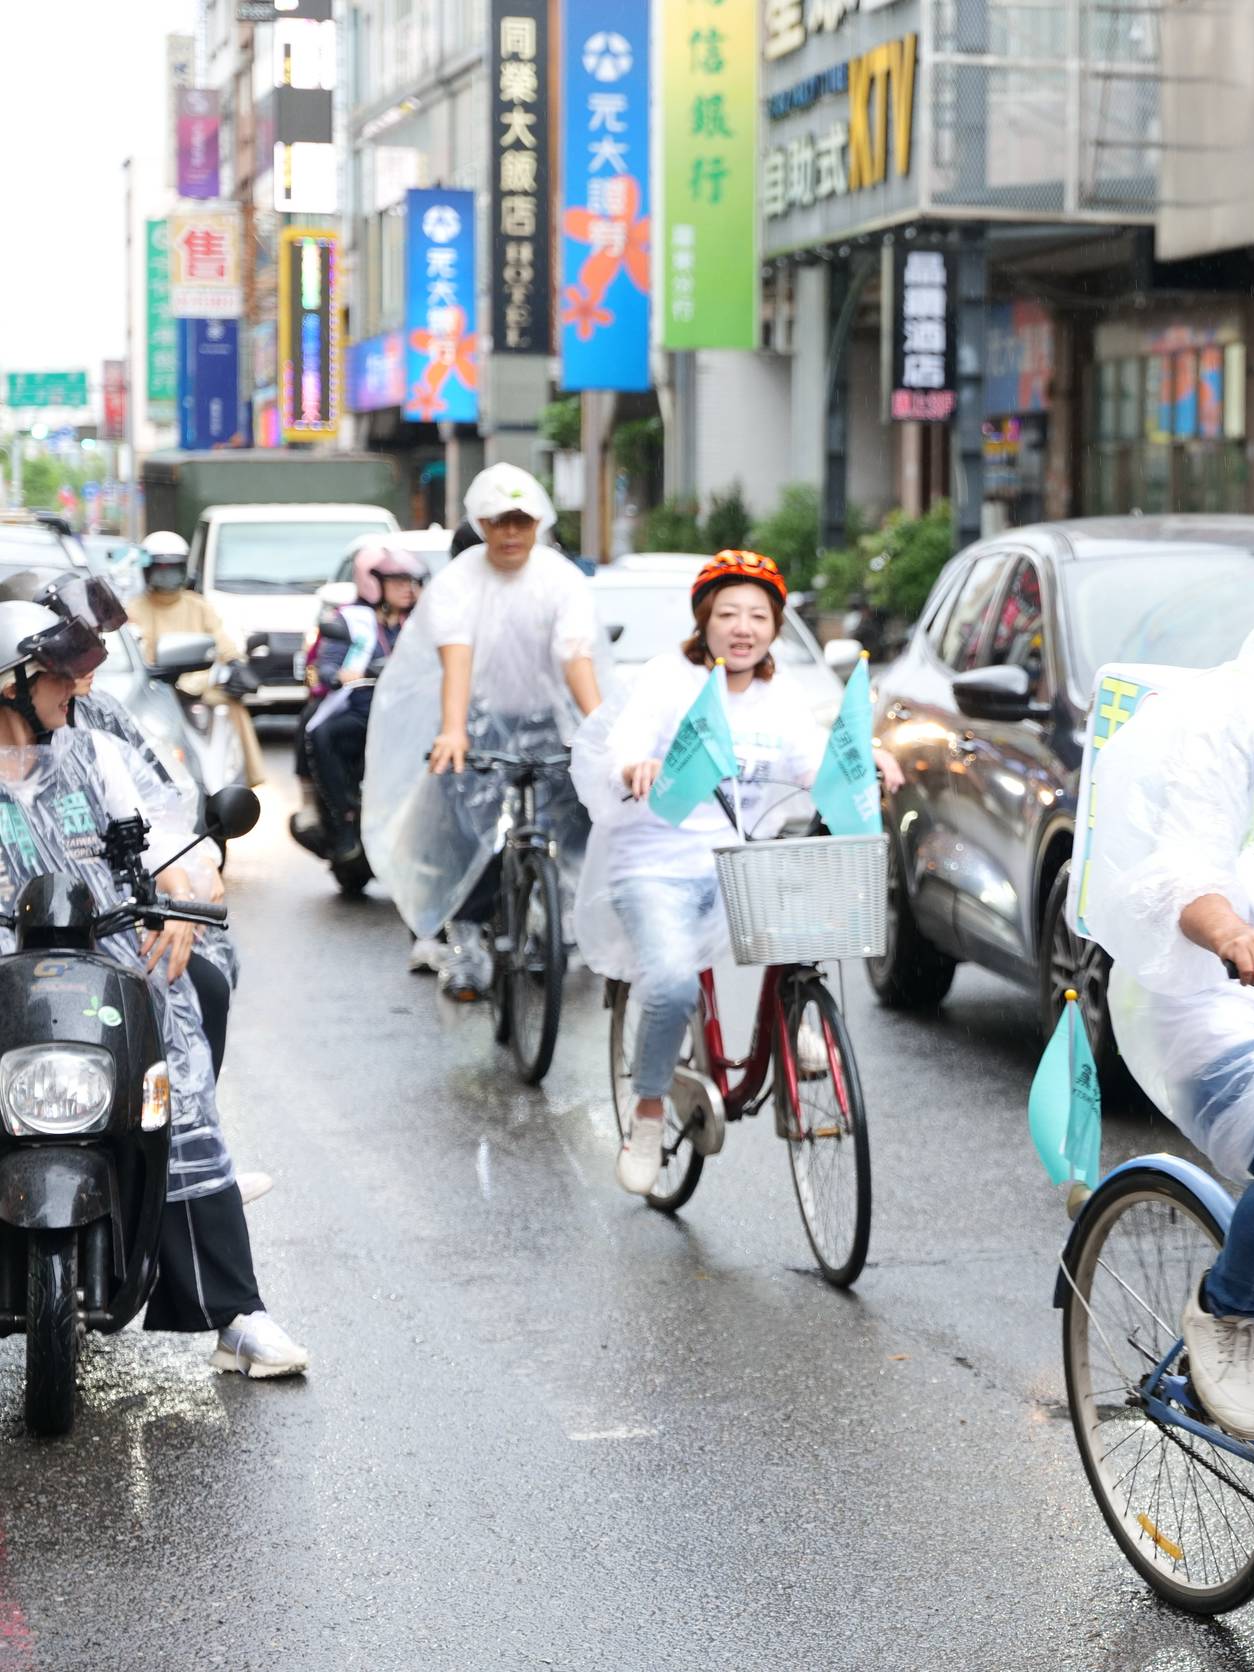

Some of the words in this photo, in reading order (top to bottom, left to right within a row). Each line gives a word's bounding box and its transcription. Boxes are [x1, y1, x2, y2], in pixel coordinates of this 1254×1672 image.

[500, 16, 538, 237] 同榮大飯店
[688, 0, 733, 205] 信銀行
[764, 118, 848, 216] 自助式
[848, 32, 917, 191] KTV
